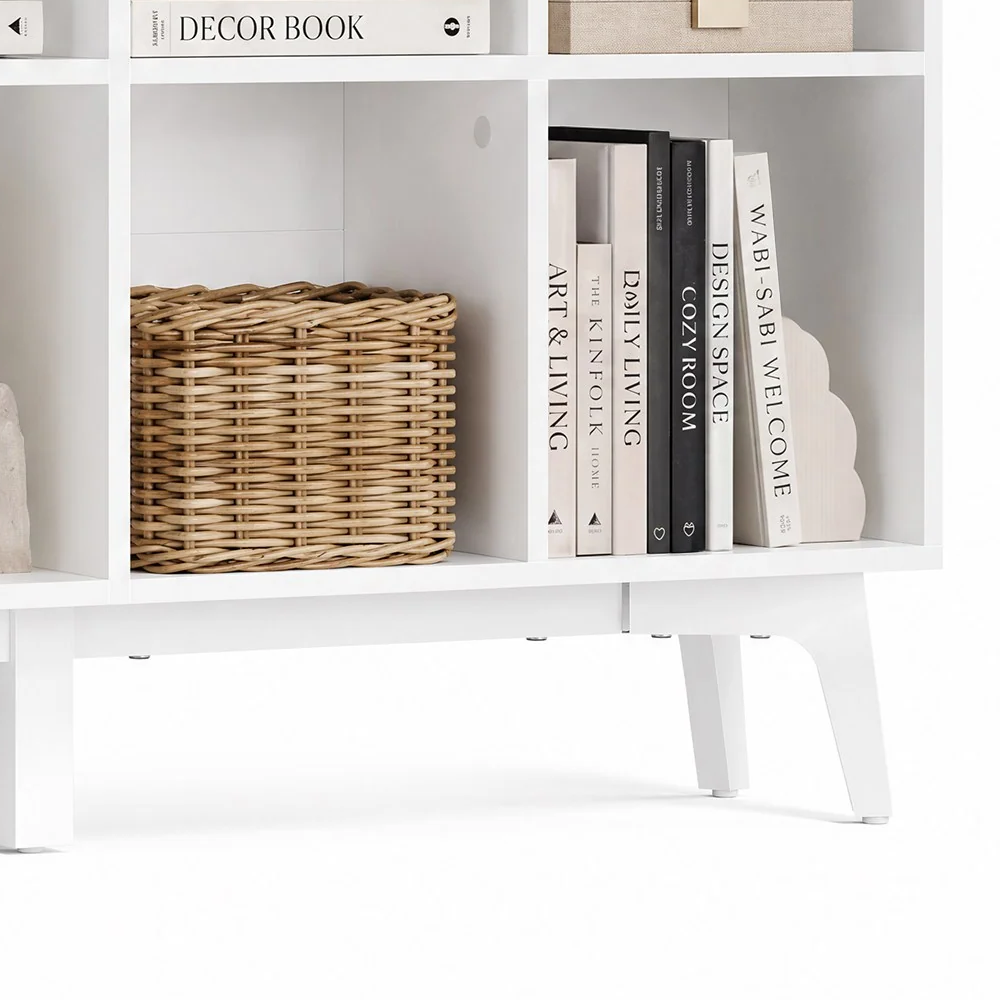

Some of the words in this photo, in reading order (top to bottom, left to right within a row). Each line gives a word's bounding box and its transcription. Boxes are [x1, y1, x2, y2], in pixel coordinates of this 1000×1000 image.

[180, 15, 276, 41] DECOR
[285, 15, 364, 41] BOOK
[548, 263, 568, 318] ART
[591, 275, 600, 307] THE
[711, 242, 730, 340] DESIGN
[750, 202, 778, 347] WABI-SABI
[548, 327, 569, 347] &
[681, 286, 697, 352] COZY
[548, 355, 569, 451] LIVING
[589, 318, 603, 436] KINFOLK
[623, 358, 641, 446] LIVING
[681, 357, 697, 431] ROOM
[711, 347, 730, 425] SPACE
[762, 356, 793, 498] WELCOME
